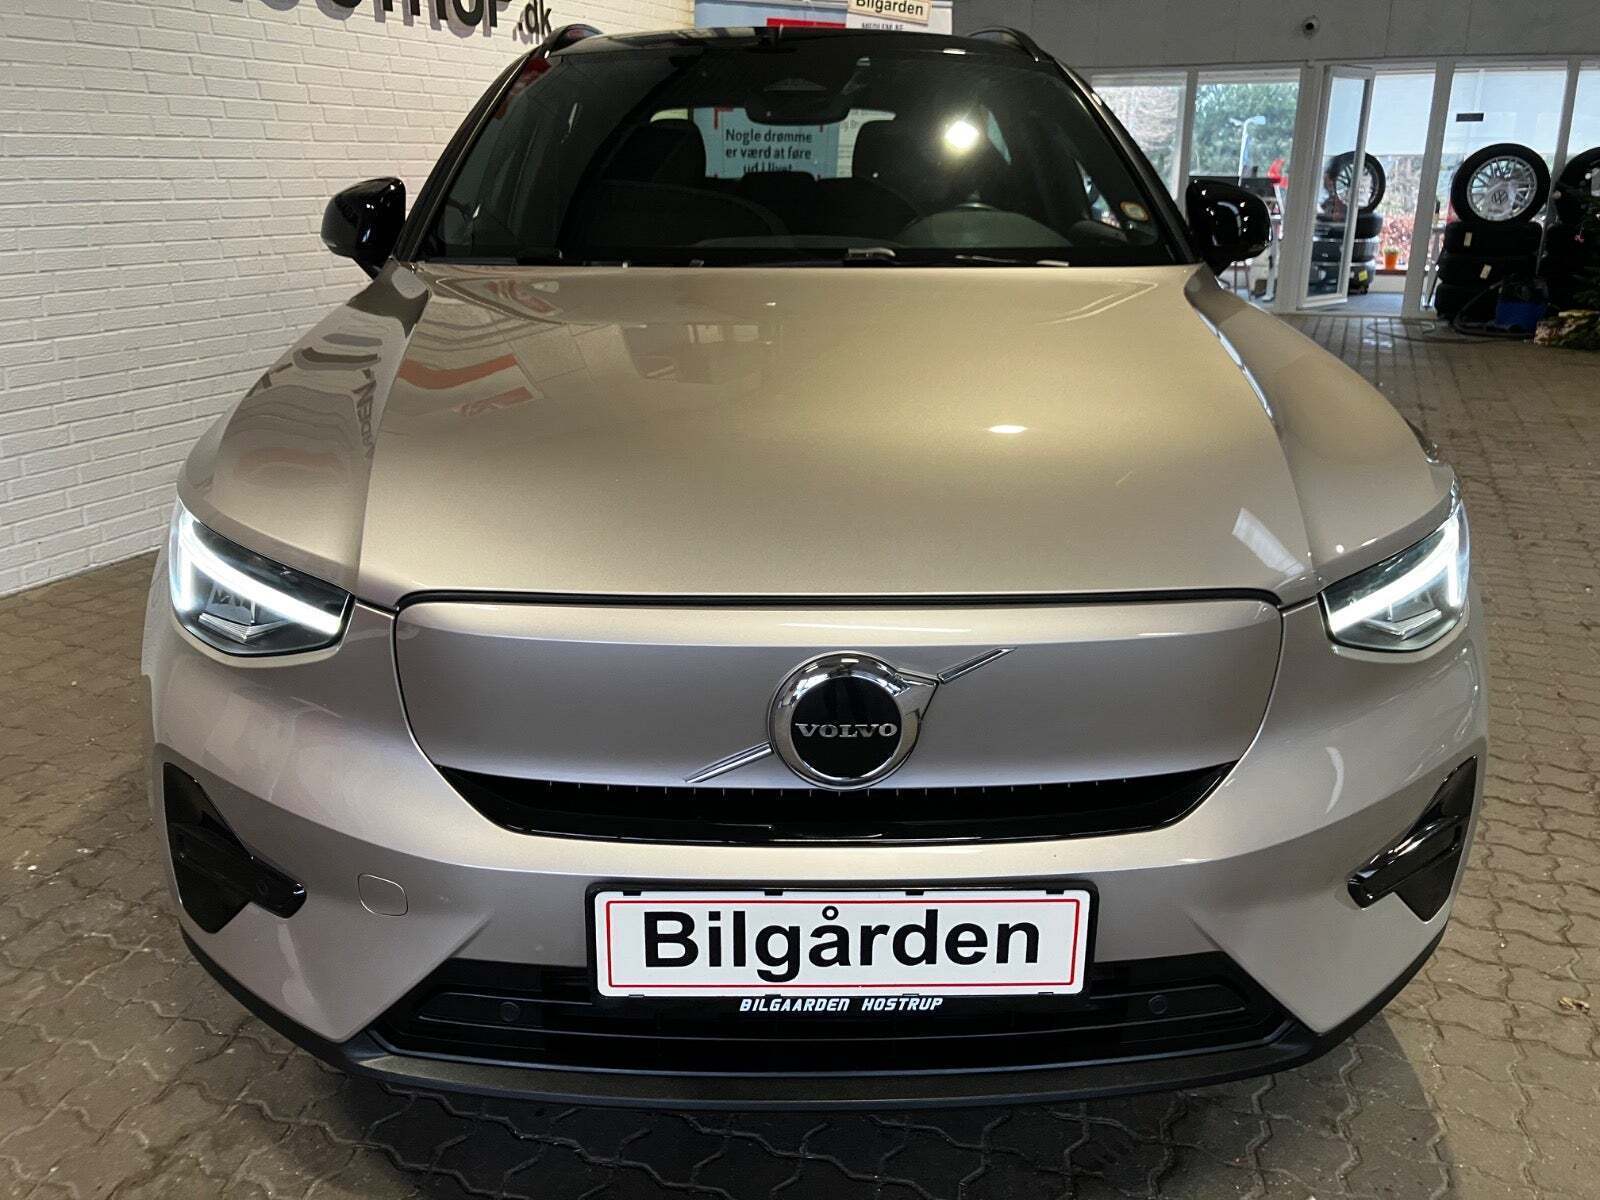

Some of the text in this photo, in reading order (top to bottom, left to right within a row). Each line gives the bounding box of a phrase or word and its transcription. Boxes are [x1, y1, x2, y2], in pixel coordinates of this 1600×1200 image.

[726, 128, 813, 145] Nogle drømme
[726, 146, 812, 159] er værd at føre
[795, 723, 898, 738] VOLVO
[643, 905, 1040, 983] Bilgården
[739, 998, 944, 1012] BILGAARDEN HOSTRUP
